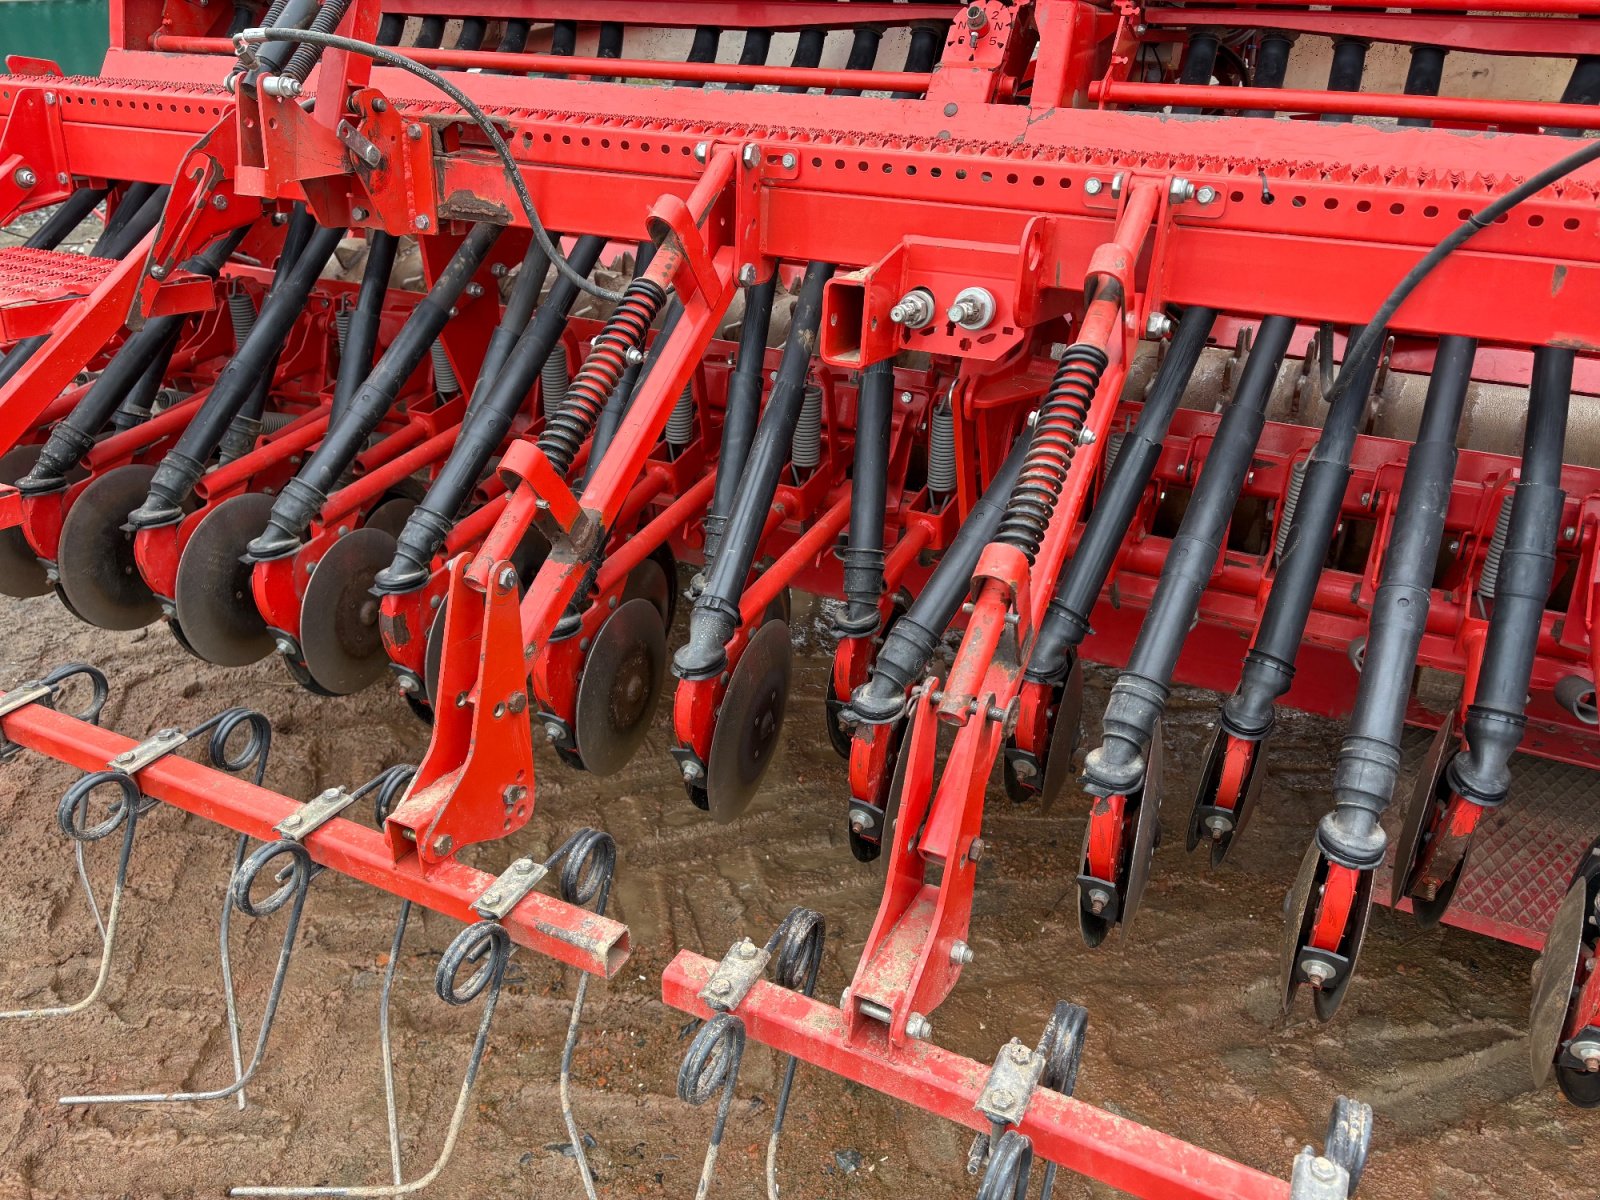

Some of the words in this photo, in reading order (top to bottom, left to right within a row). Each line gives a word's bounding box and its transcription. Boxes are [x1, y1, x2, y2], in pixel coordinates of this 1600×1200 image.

[991, 11, 999, 20] 2
[958, 21, 967, 30] N
[994, 22, 1003, 31] N
[989, 37, 997, 46] 5
